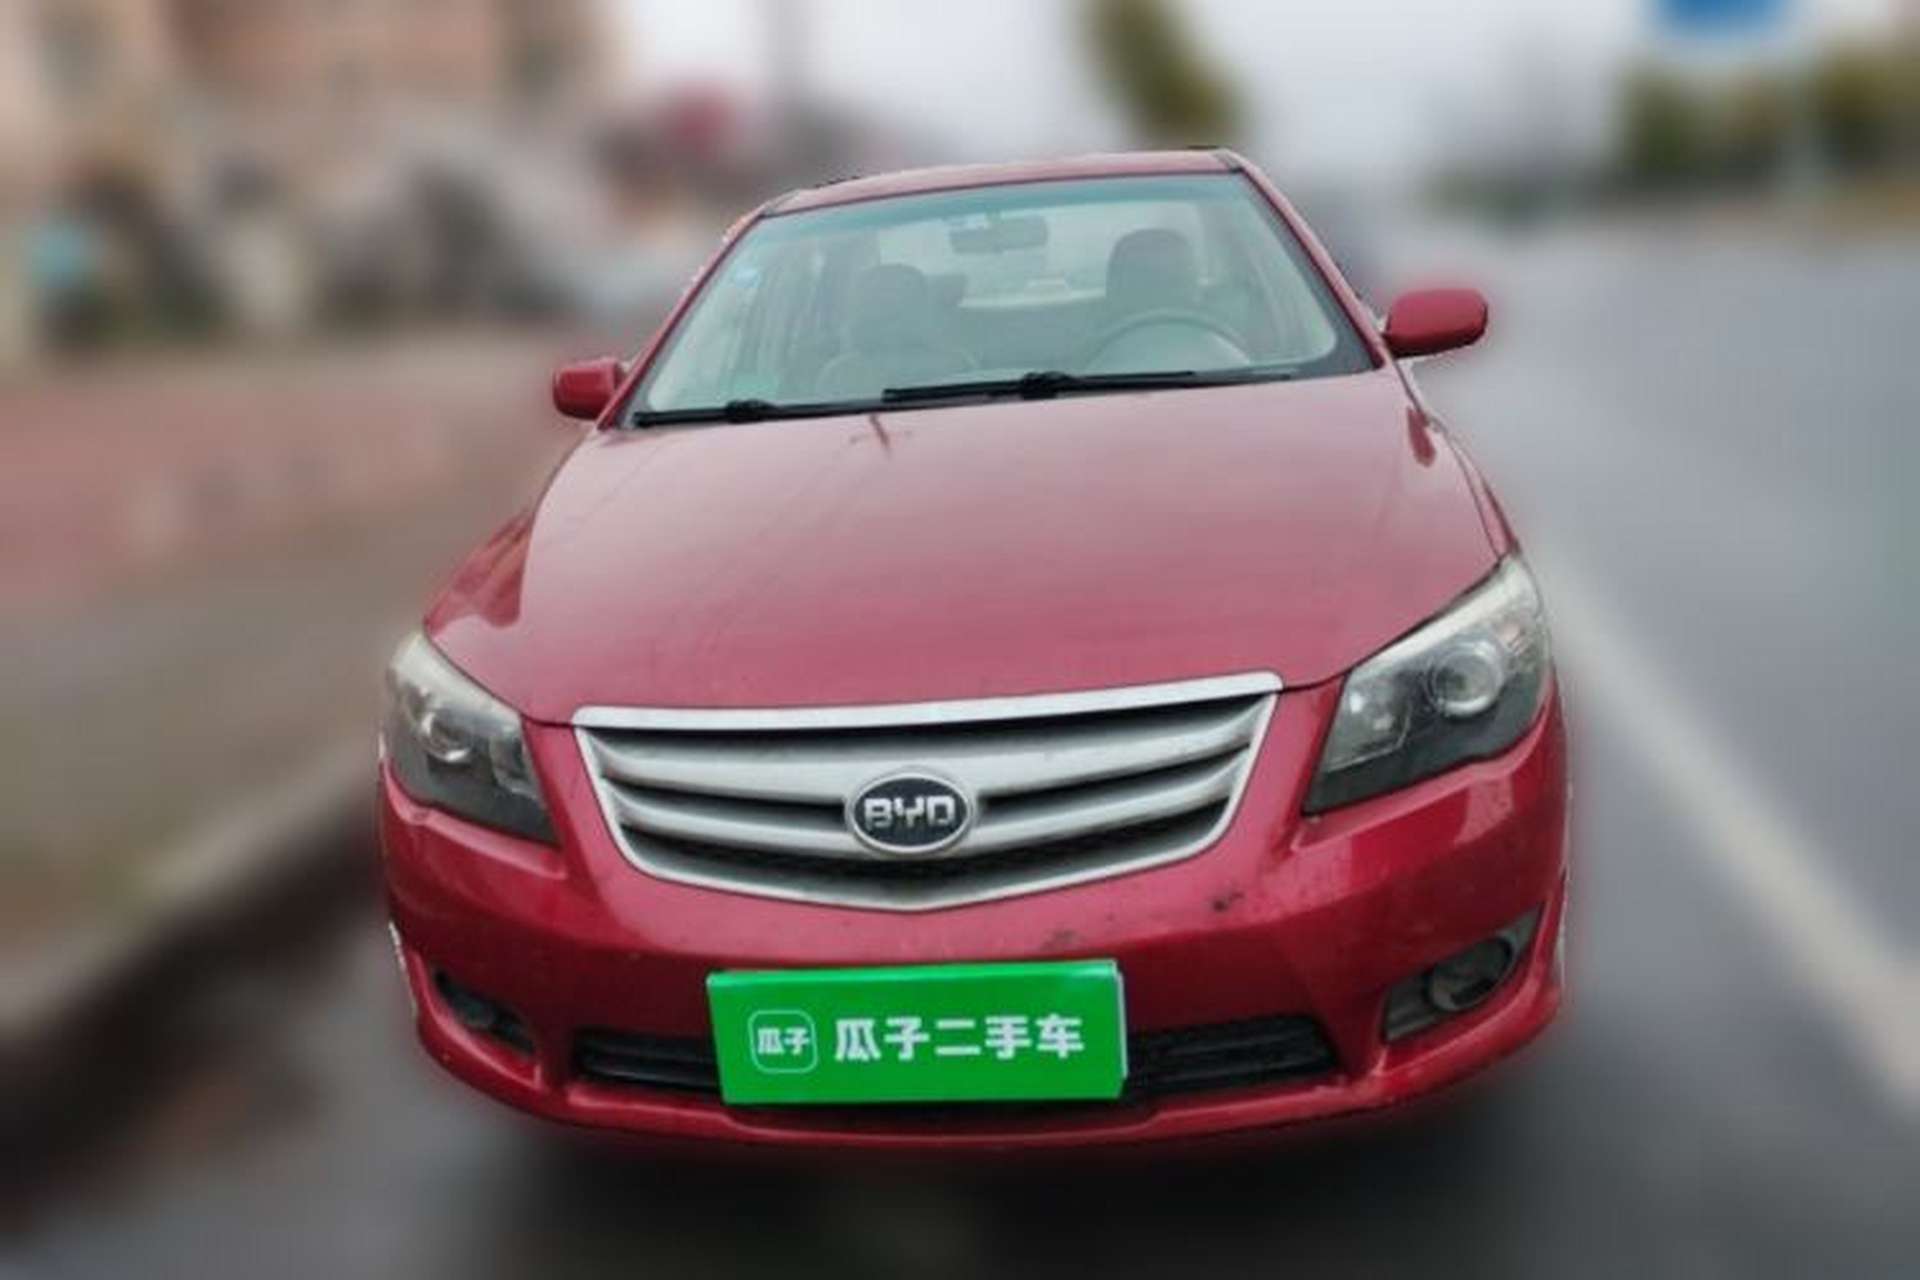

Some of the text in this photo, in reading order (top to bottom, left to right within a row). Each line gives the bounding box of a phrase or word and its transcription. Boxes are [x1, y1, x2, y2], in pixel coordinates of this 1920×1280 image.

[864, 795, 956, 831] BYD
[756, 1027, 811, 1057] 瓜子
[834, 1013, 1085, 1062] 瓜子二手车
